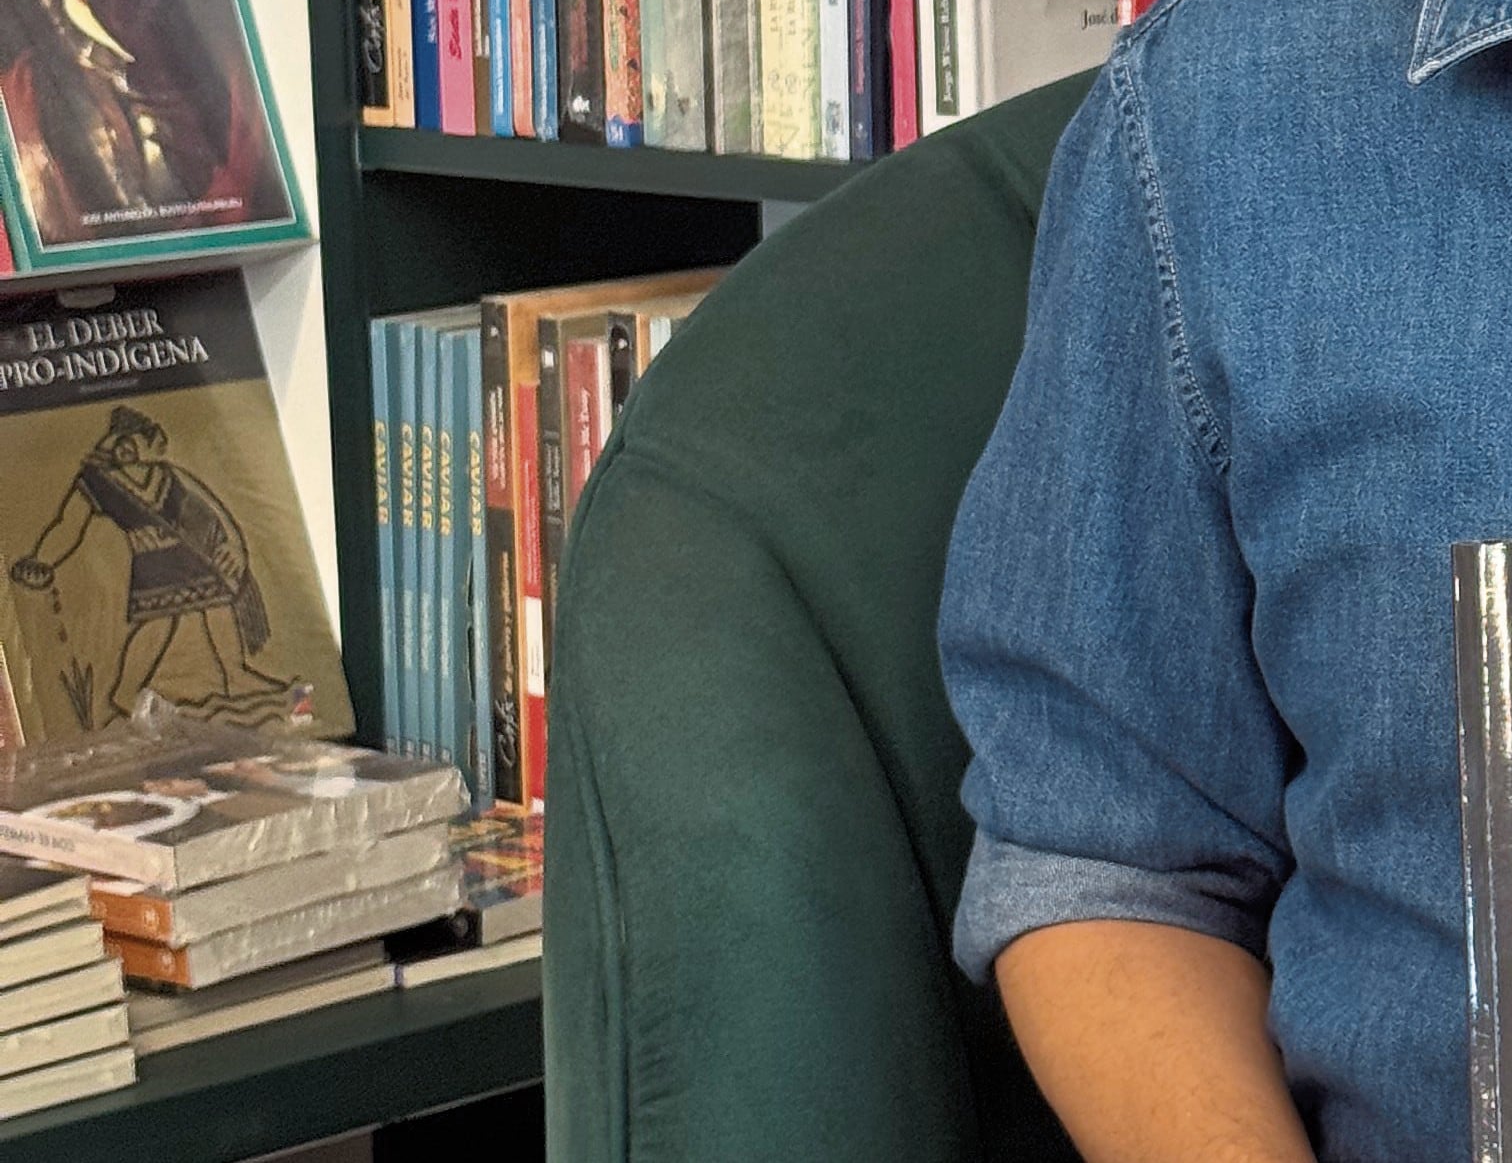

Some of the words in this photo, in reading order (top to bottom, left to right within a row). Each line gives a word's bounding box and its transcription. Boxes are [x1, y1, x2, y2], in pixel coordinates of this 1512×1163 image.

[28, 325, 64, 352] EL
[67, 308, 164, 345] DEBER
[375, 420, 390, 525] CAVIAR
[401, 421, 414, 527] CAVIAR
[421, 425, 433, 530] CAVIAR
[440, 430, 452, 535] CAVIAR
[470, 430, 482, 536] CAVIAR
